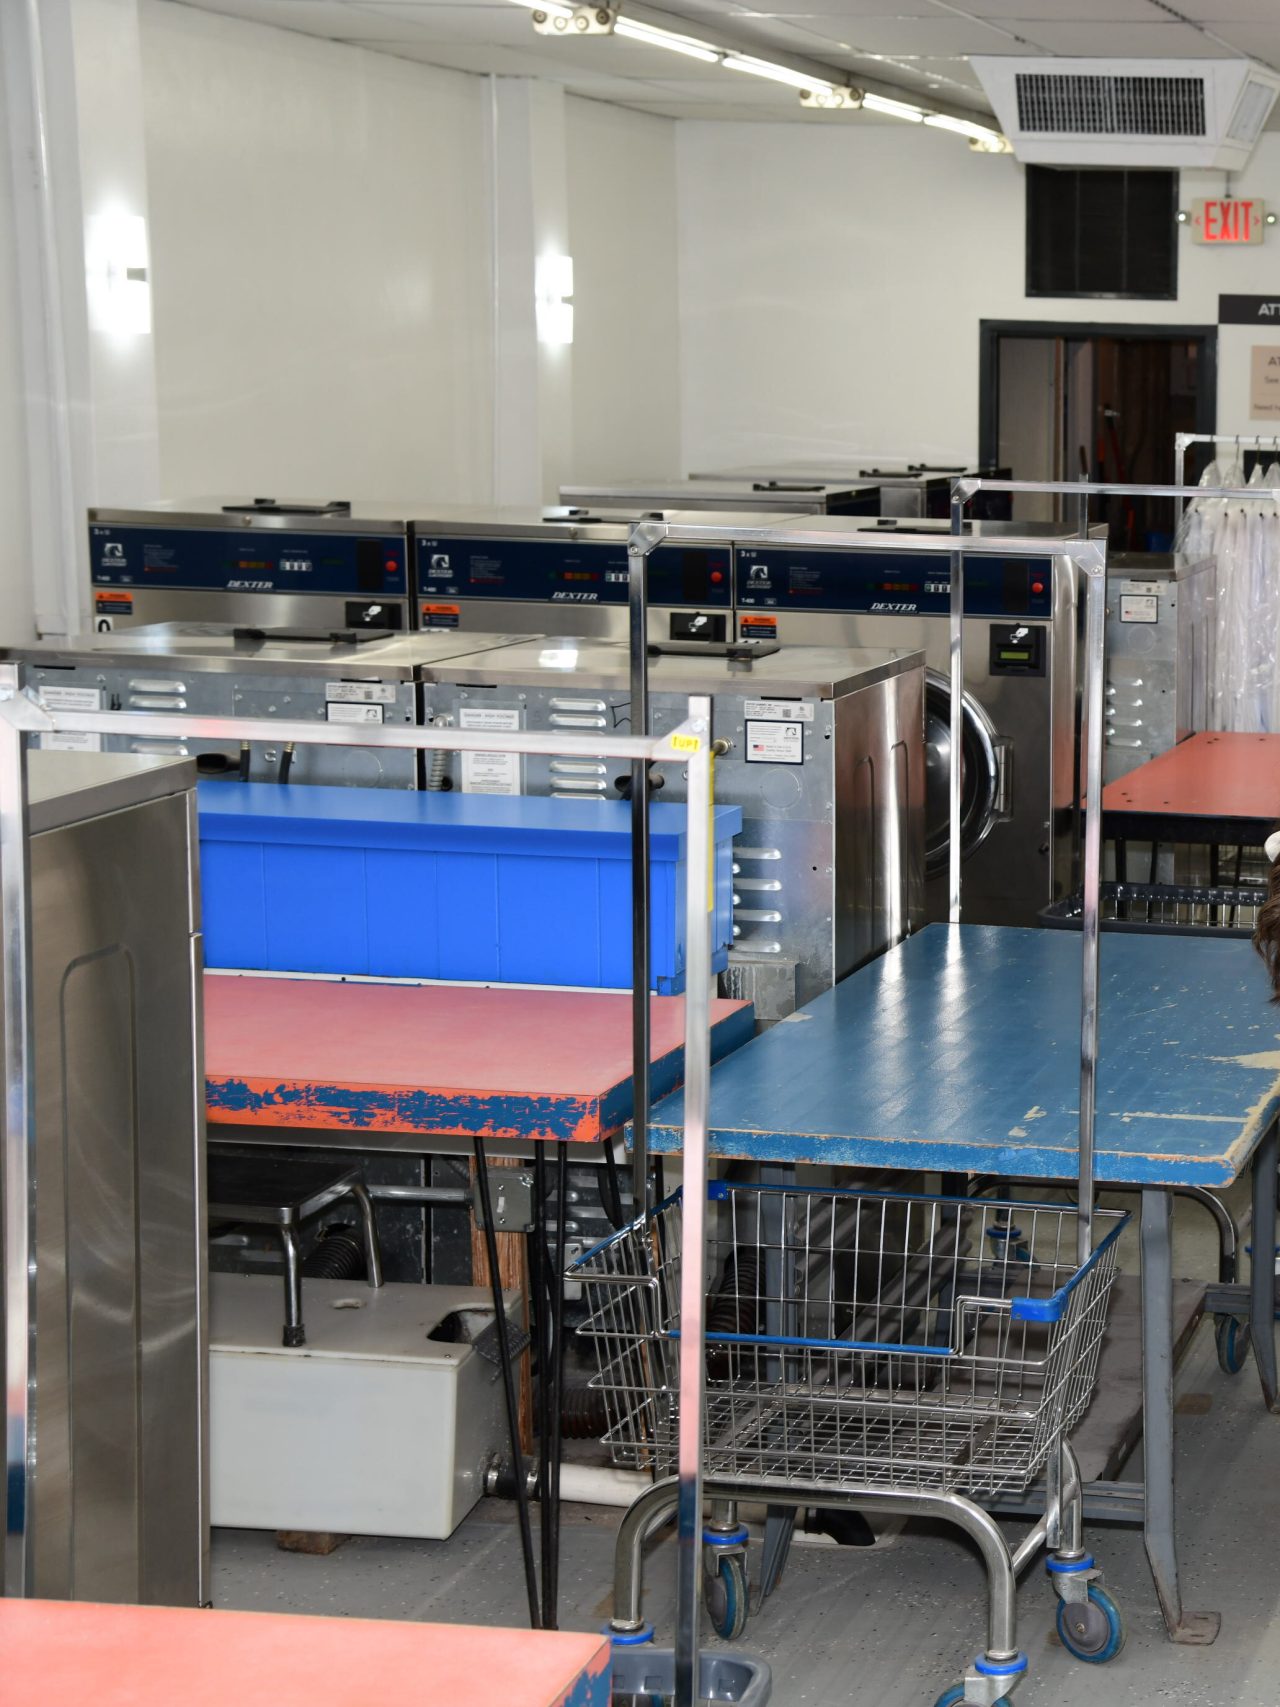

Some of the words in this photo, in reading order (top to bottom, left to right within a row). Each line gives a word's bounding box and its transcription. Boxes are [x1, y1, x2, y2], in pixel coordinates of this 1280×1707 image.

[1204, 201, 1254, 241] EXIT
[1264, 375, 1279, 384] See
[226, 579, 274, 589] DEXTER
[551, 591, 599, 601] DEXTER
[869, 602, 918, 611] DEXTER
